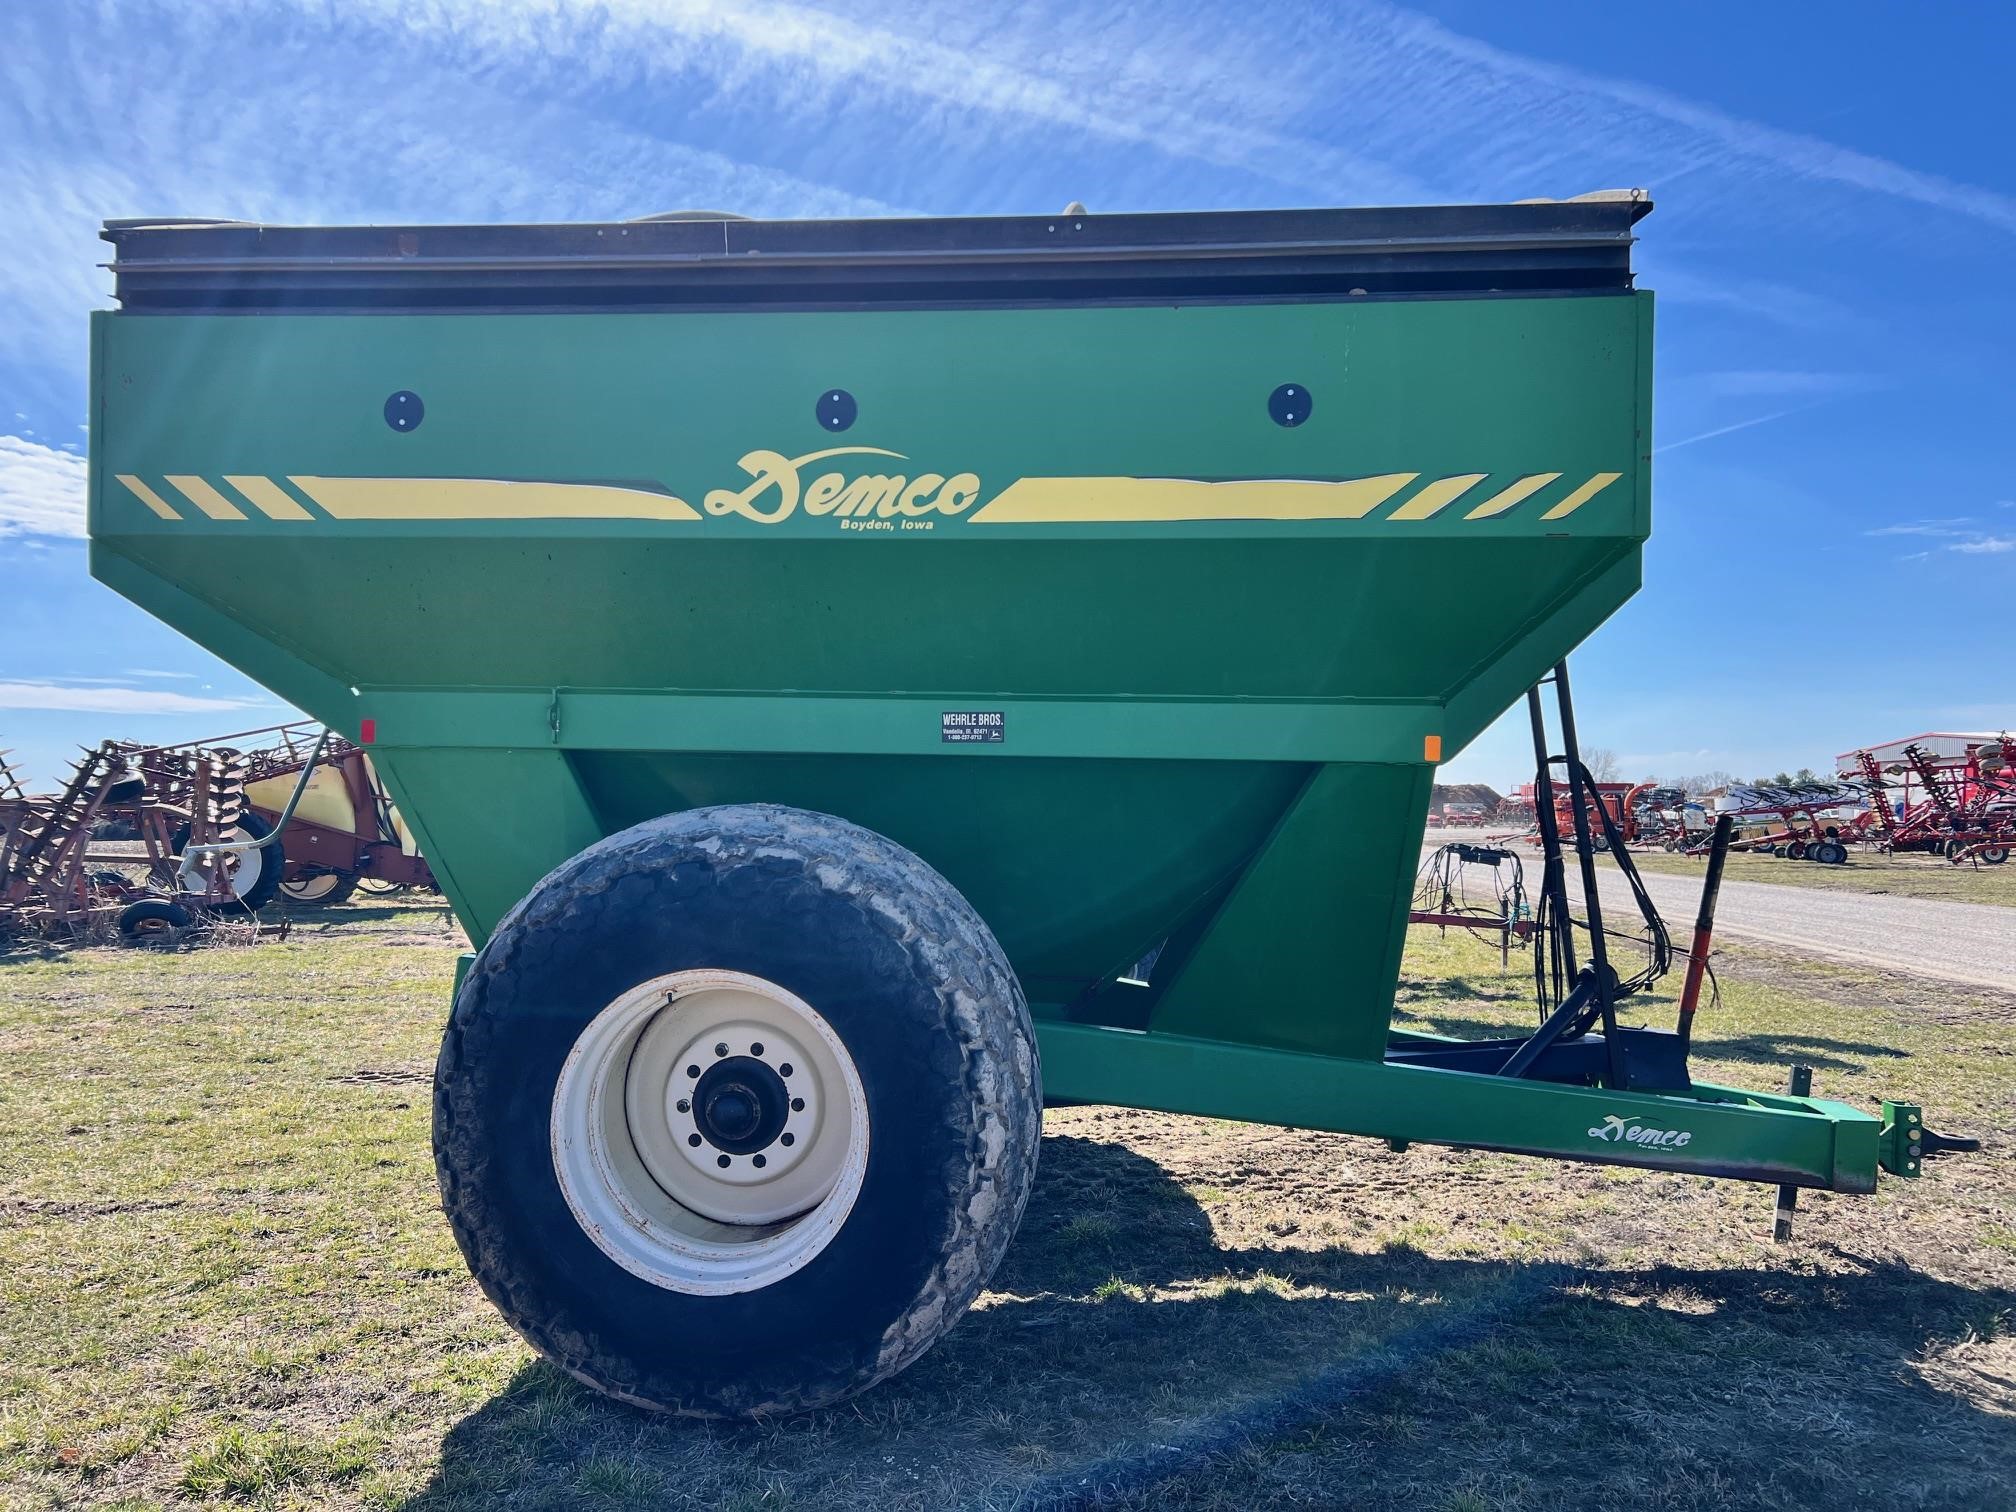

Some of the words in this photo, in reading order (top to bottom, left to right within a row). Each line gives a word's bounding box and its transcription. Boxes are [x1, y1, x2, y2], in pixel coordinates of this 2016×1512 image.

[704, 446, 980, 523] Demco
[840, 519, 894, 532] Boyden,
[901, 519, 934, 530] Iowa
[943, 713, 976, 726] WEHRLE
[978, 713, 1004, 726] BROS.
